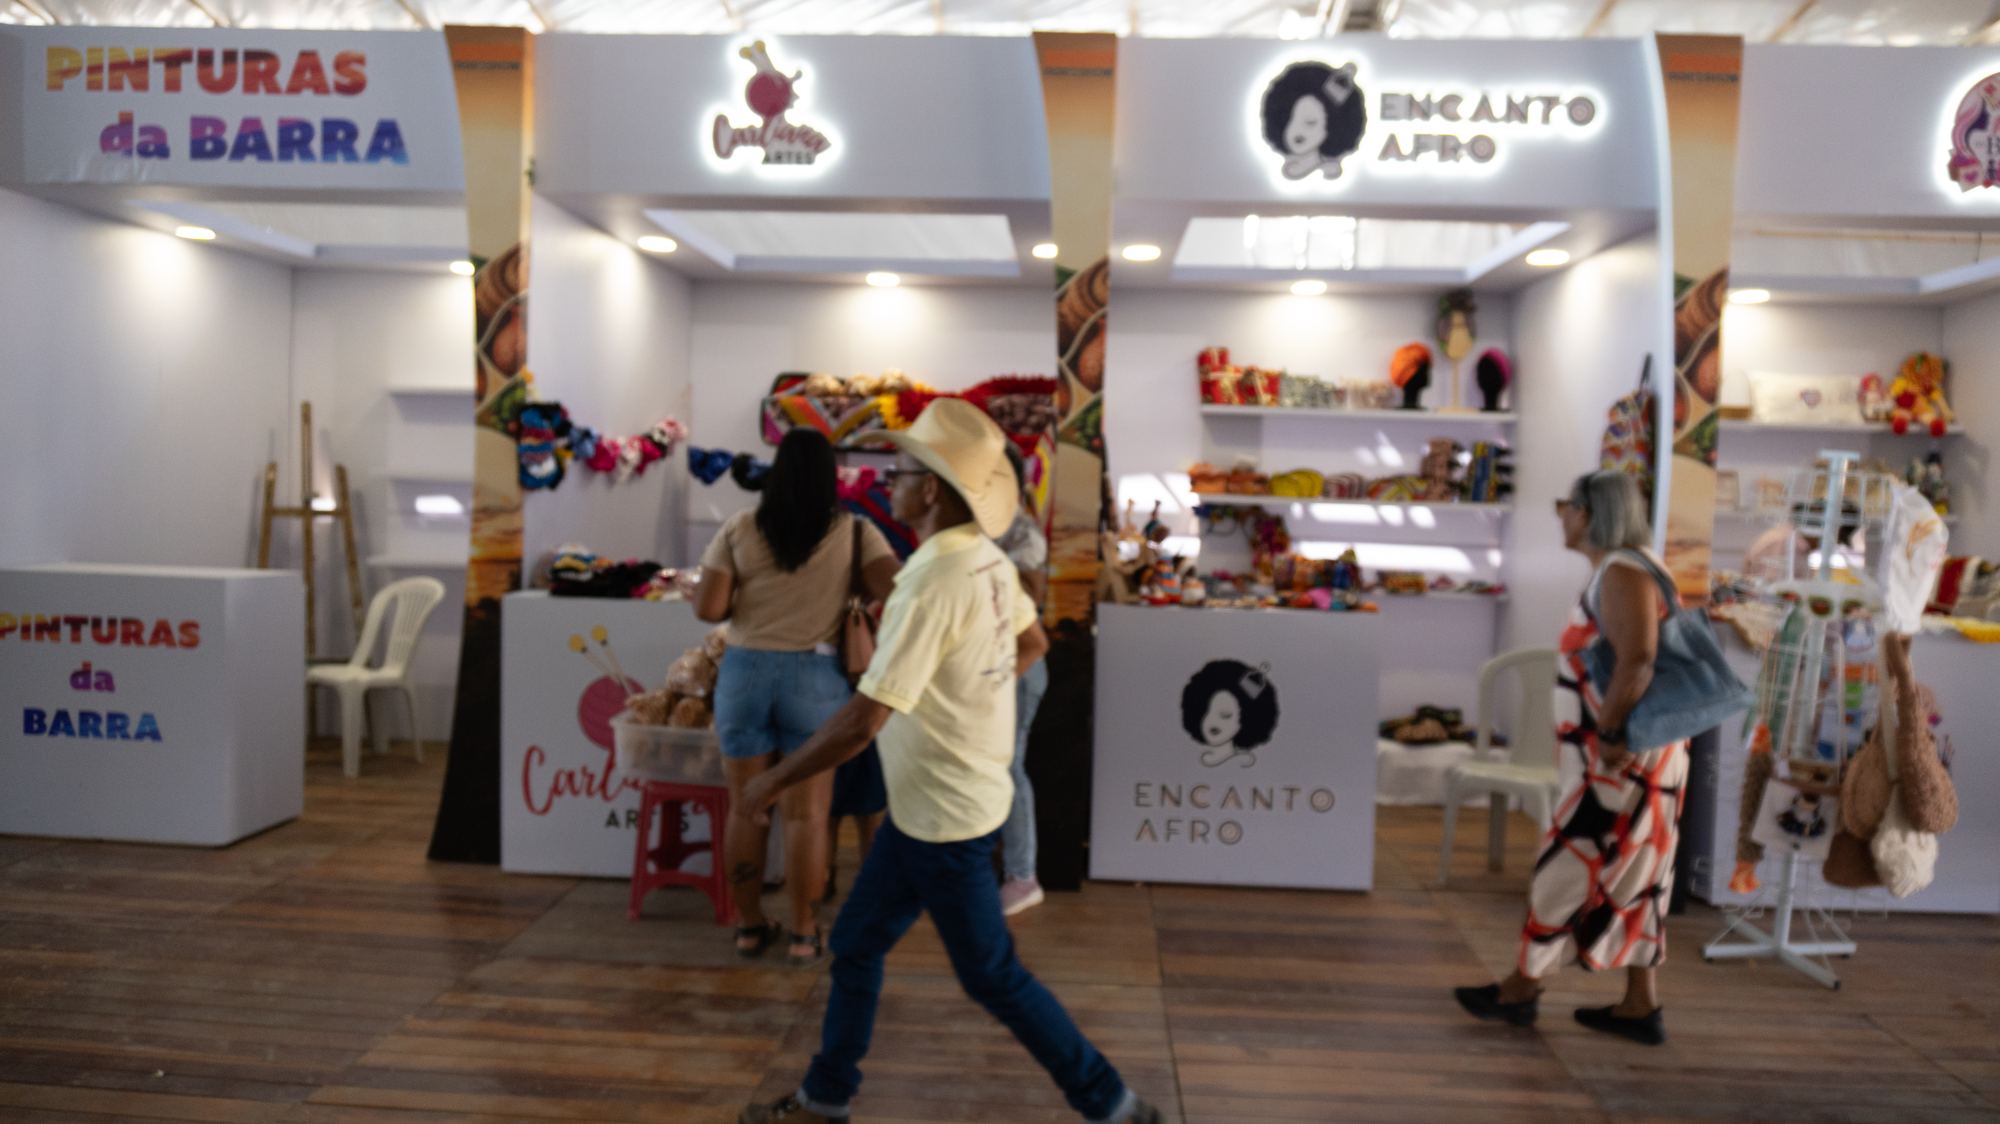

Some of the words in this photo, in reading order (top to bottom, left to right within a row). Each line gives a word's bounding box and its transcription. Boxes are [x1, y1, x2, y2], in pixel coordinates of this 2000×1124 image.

[46, 46, 367, 96] PINTURAS
[1379, 93, 1596, 126] ENCANTO
[100, 111, 170, 159] da
[189, 115, 410, 164] BARRA
[1377, 132, 1496, 164] AFRO
[762, 150, 816, 164] ARTES
[0, 613, 201, 649] PINTURAS
[69, 661, 116, 692] da
[23, 707, 163, 742] BARRA
[1133, 782, 1336, 814] ENCANTO
[1135, 818, 1243, 846] AFRO
